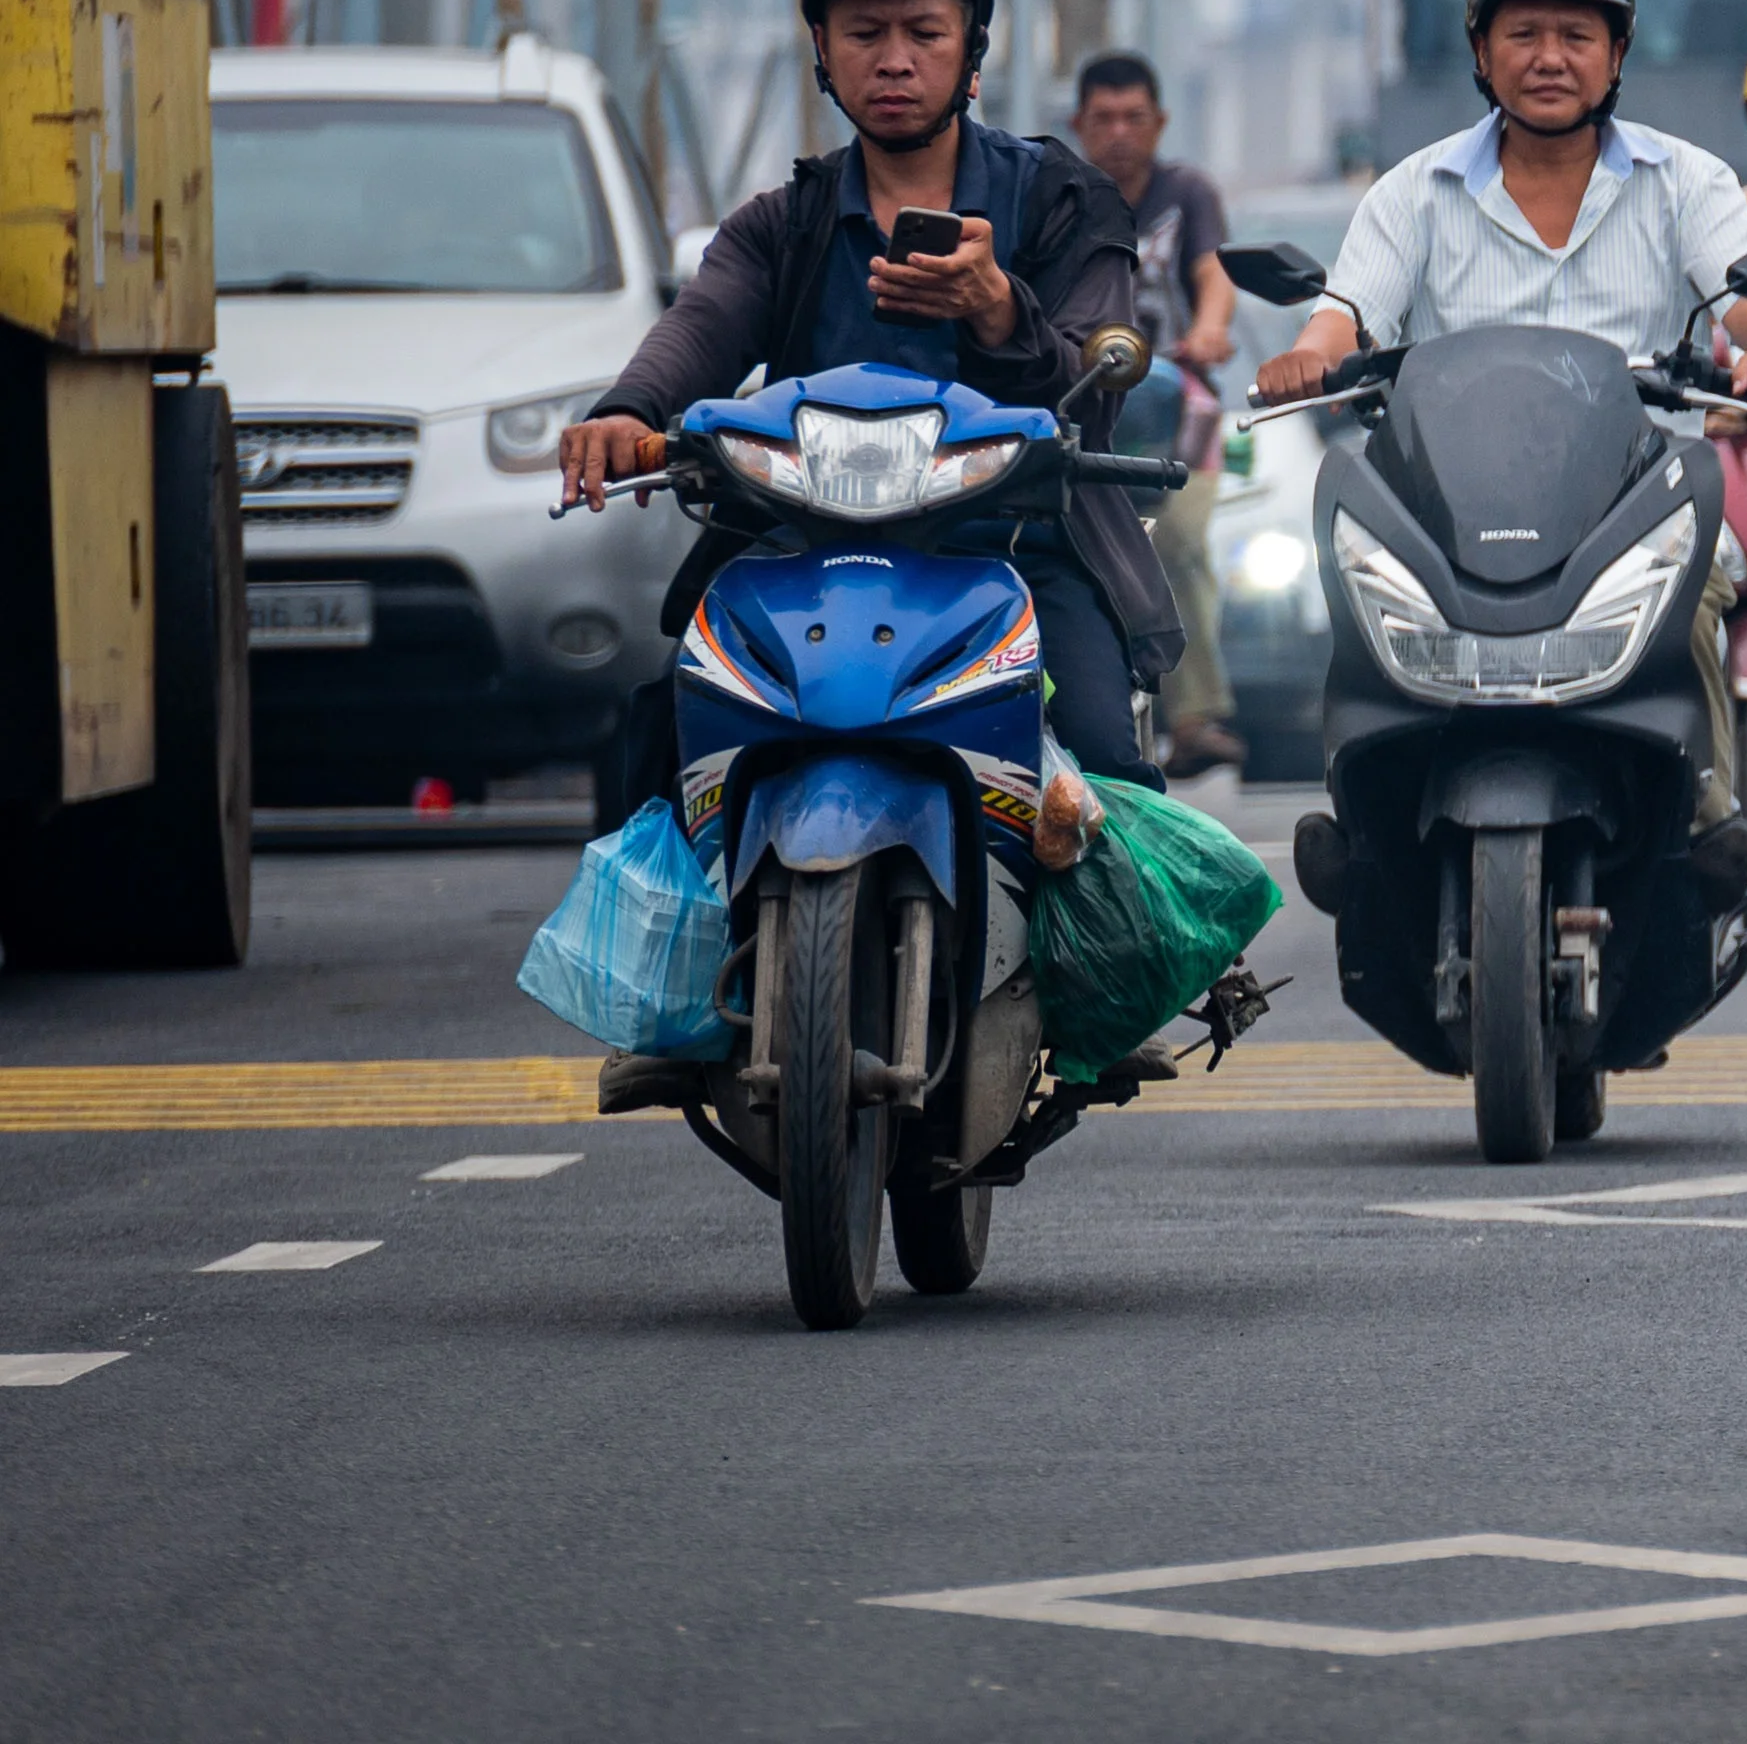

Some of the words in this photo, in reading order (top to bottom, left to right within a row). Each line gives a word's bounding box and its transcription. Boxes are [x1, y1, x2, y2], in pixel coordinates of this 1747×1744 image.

[1480, 528, 1540, 542] HONDA
[822, 555, 894, 568] HONDA
[994, 641, 1037, 668] RS
[980, 788, 1038, 822] 110
